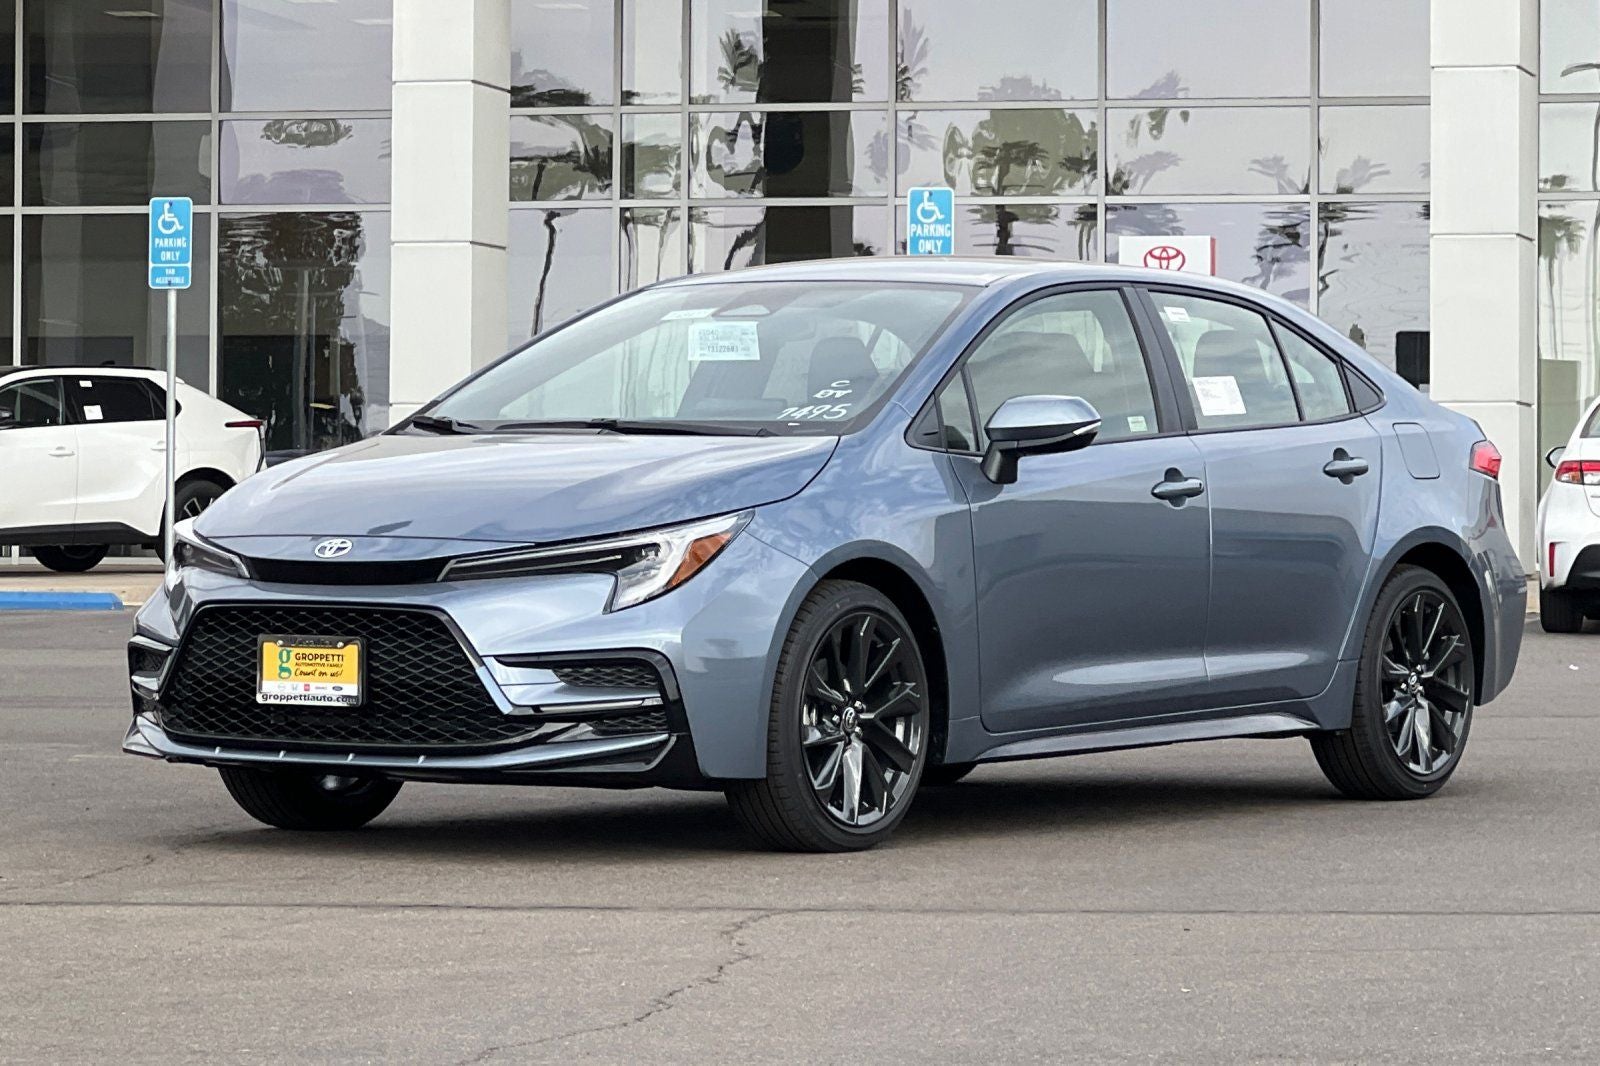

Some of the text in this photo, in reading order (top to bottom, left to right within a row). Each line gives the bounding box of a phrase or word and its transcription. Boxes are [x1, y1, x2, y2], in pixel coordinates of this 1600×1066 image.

[910, 223, 951, 237] PARKING
[154, 237, 187, 248] PARKING
[918, 239, 943, 253] ONLY
[160, 250, 181, 261] ONLY
[295, 653, 344, 662] GROPPETTI
[294, 668, 318, 677] Count
[261, 693, 357, 704] groppettiauto.com
